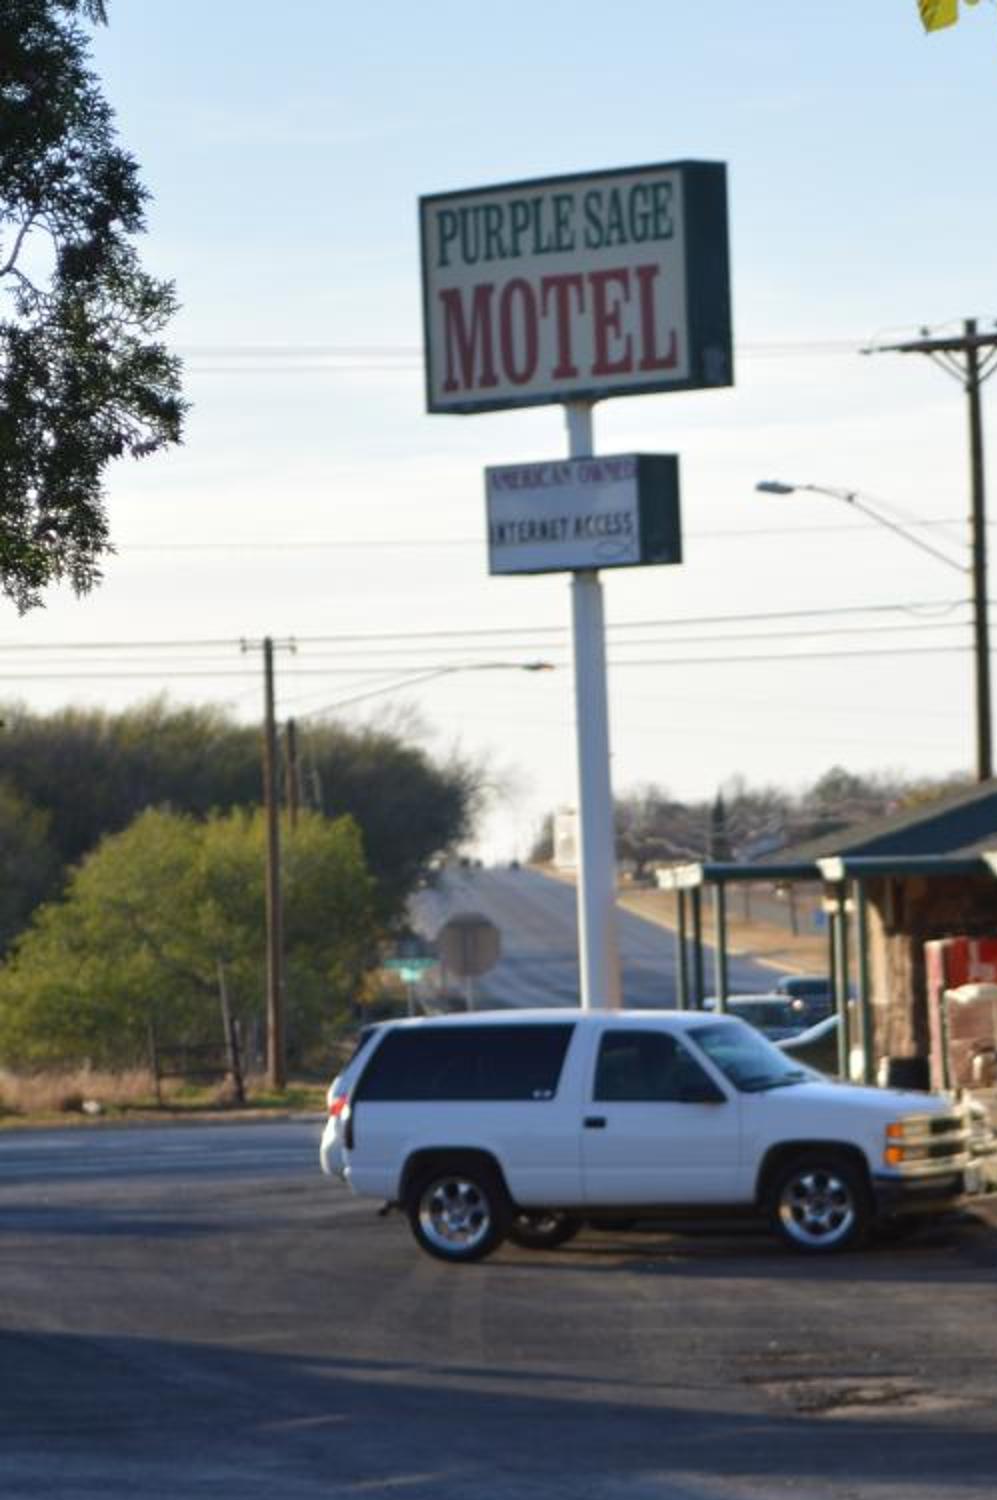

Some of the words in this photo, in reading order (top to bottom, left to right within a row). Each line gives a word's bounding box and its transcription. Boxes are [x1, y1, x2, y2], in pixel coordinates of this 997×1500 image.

[437, 194, 575, 267] PURPLE
[584, 180, 674, 250] SAGE
[438, 264, 678, 393] MOTEL
[573, 511, 633, 539] ACCESS
